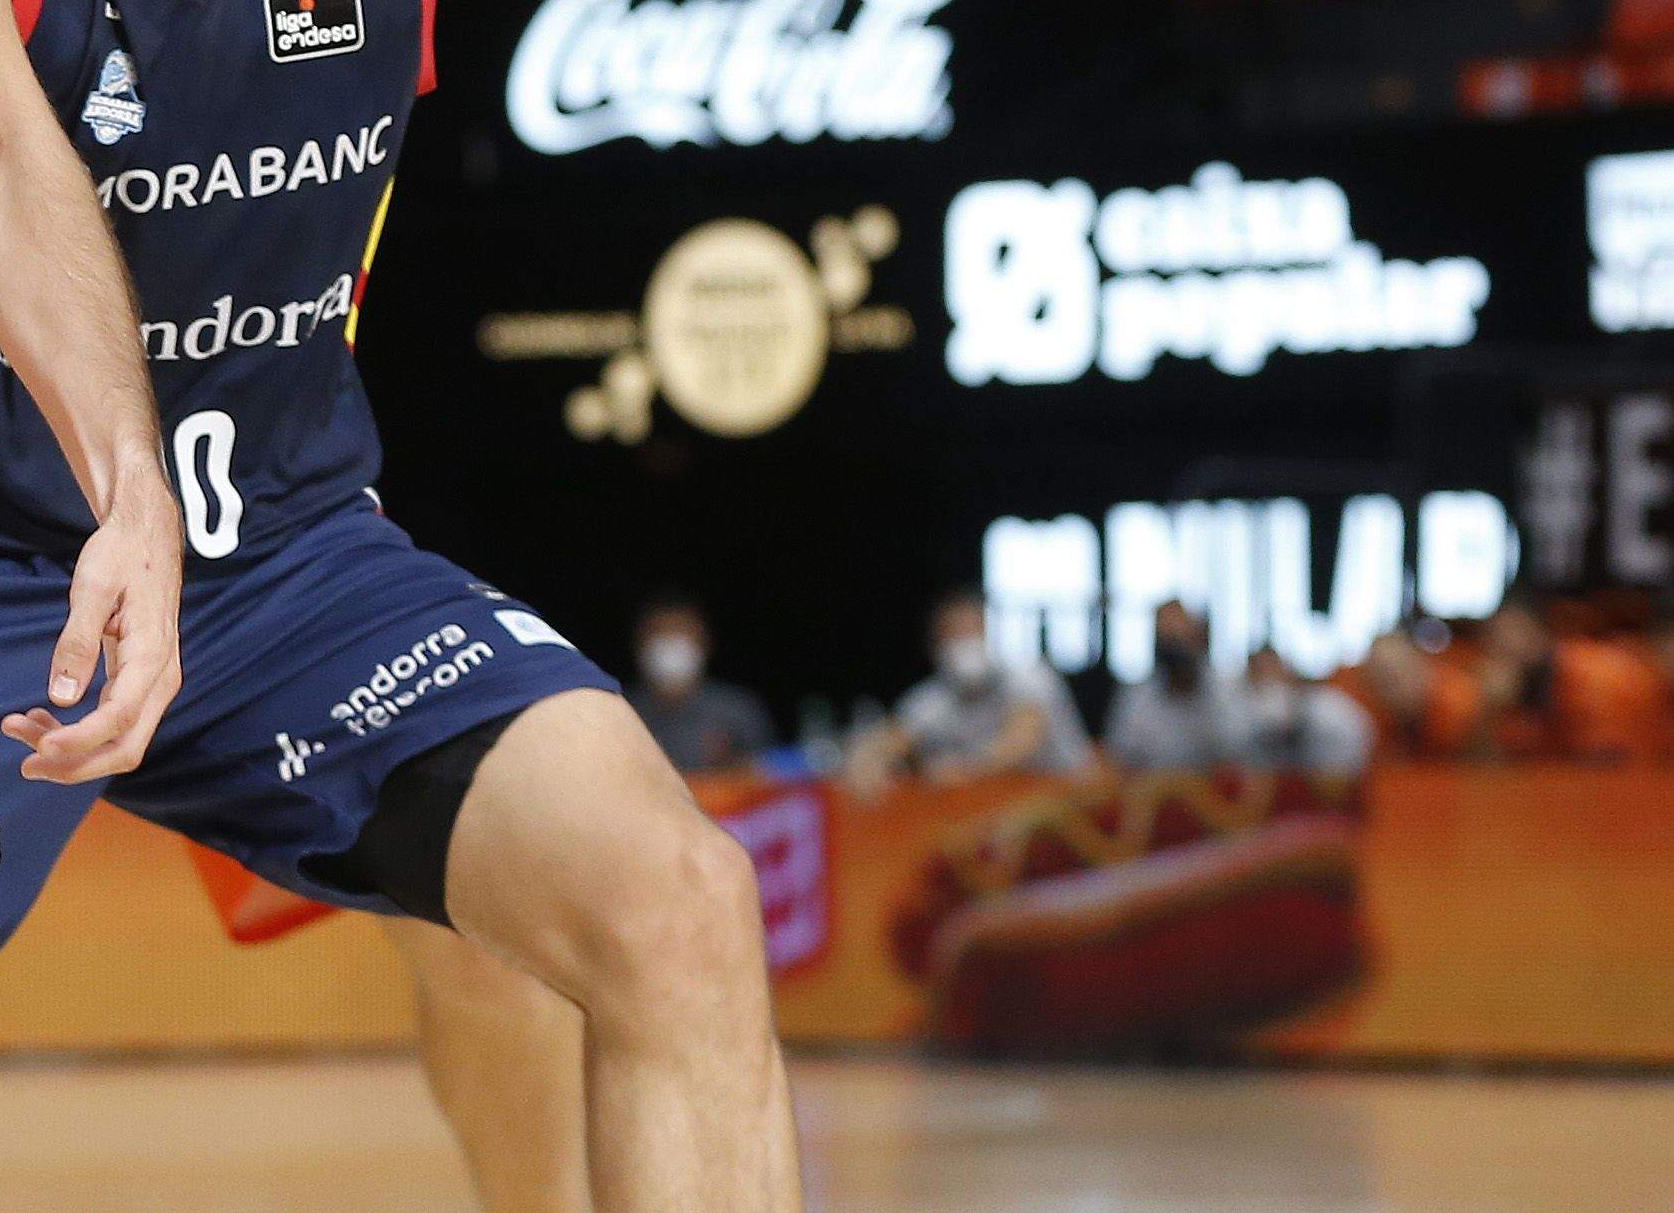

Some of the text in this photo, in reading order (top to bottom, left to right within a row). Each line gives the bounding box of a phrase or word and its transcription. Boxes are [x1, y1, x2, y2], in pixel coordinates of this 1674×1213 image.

[275, 10, 314, 34] liga
[277, 23, 357, 51] endesa
[139, 272, 354, 361] ndorra
[172, 408, 244, 560] 0
[329, 622, 468, 722] andorra
